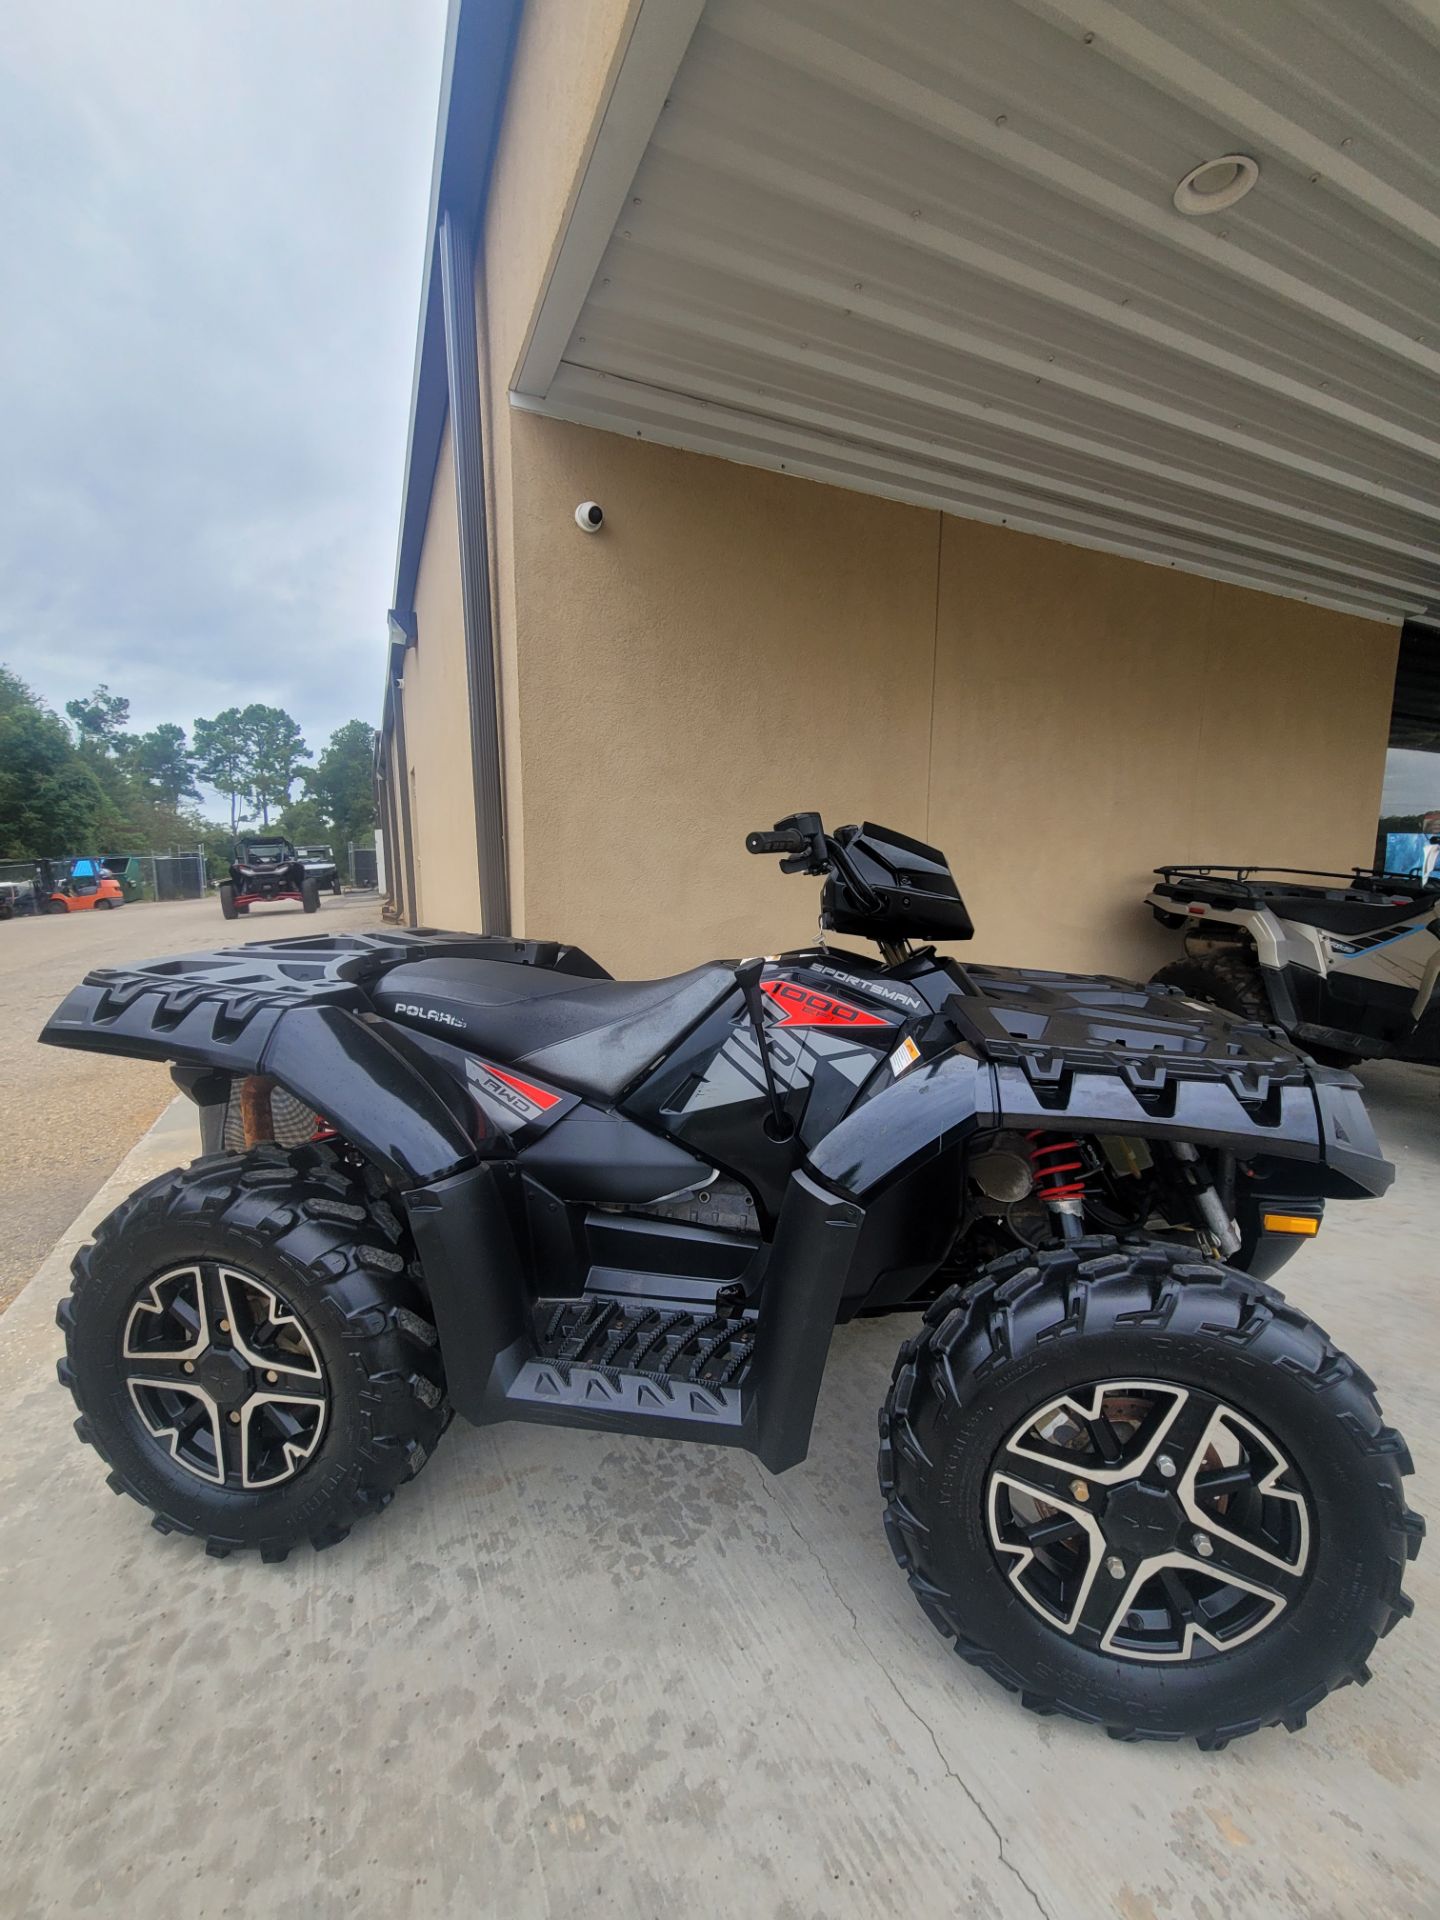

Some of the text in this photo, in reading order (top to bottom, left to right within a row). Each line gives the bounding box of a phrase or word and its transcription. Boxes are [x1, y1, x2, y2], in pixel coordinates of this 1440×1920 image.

[772, 983, 858, 1021] 1000
[809, 963, 920, 1008] SPORTSMAN
[482, 1079, 530, 1112] AWD
